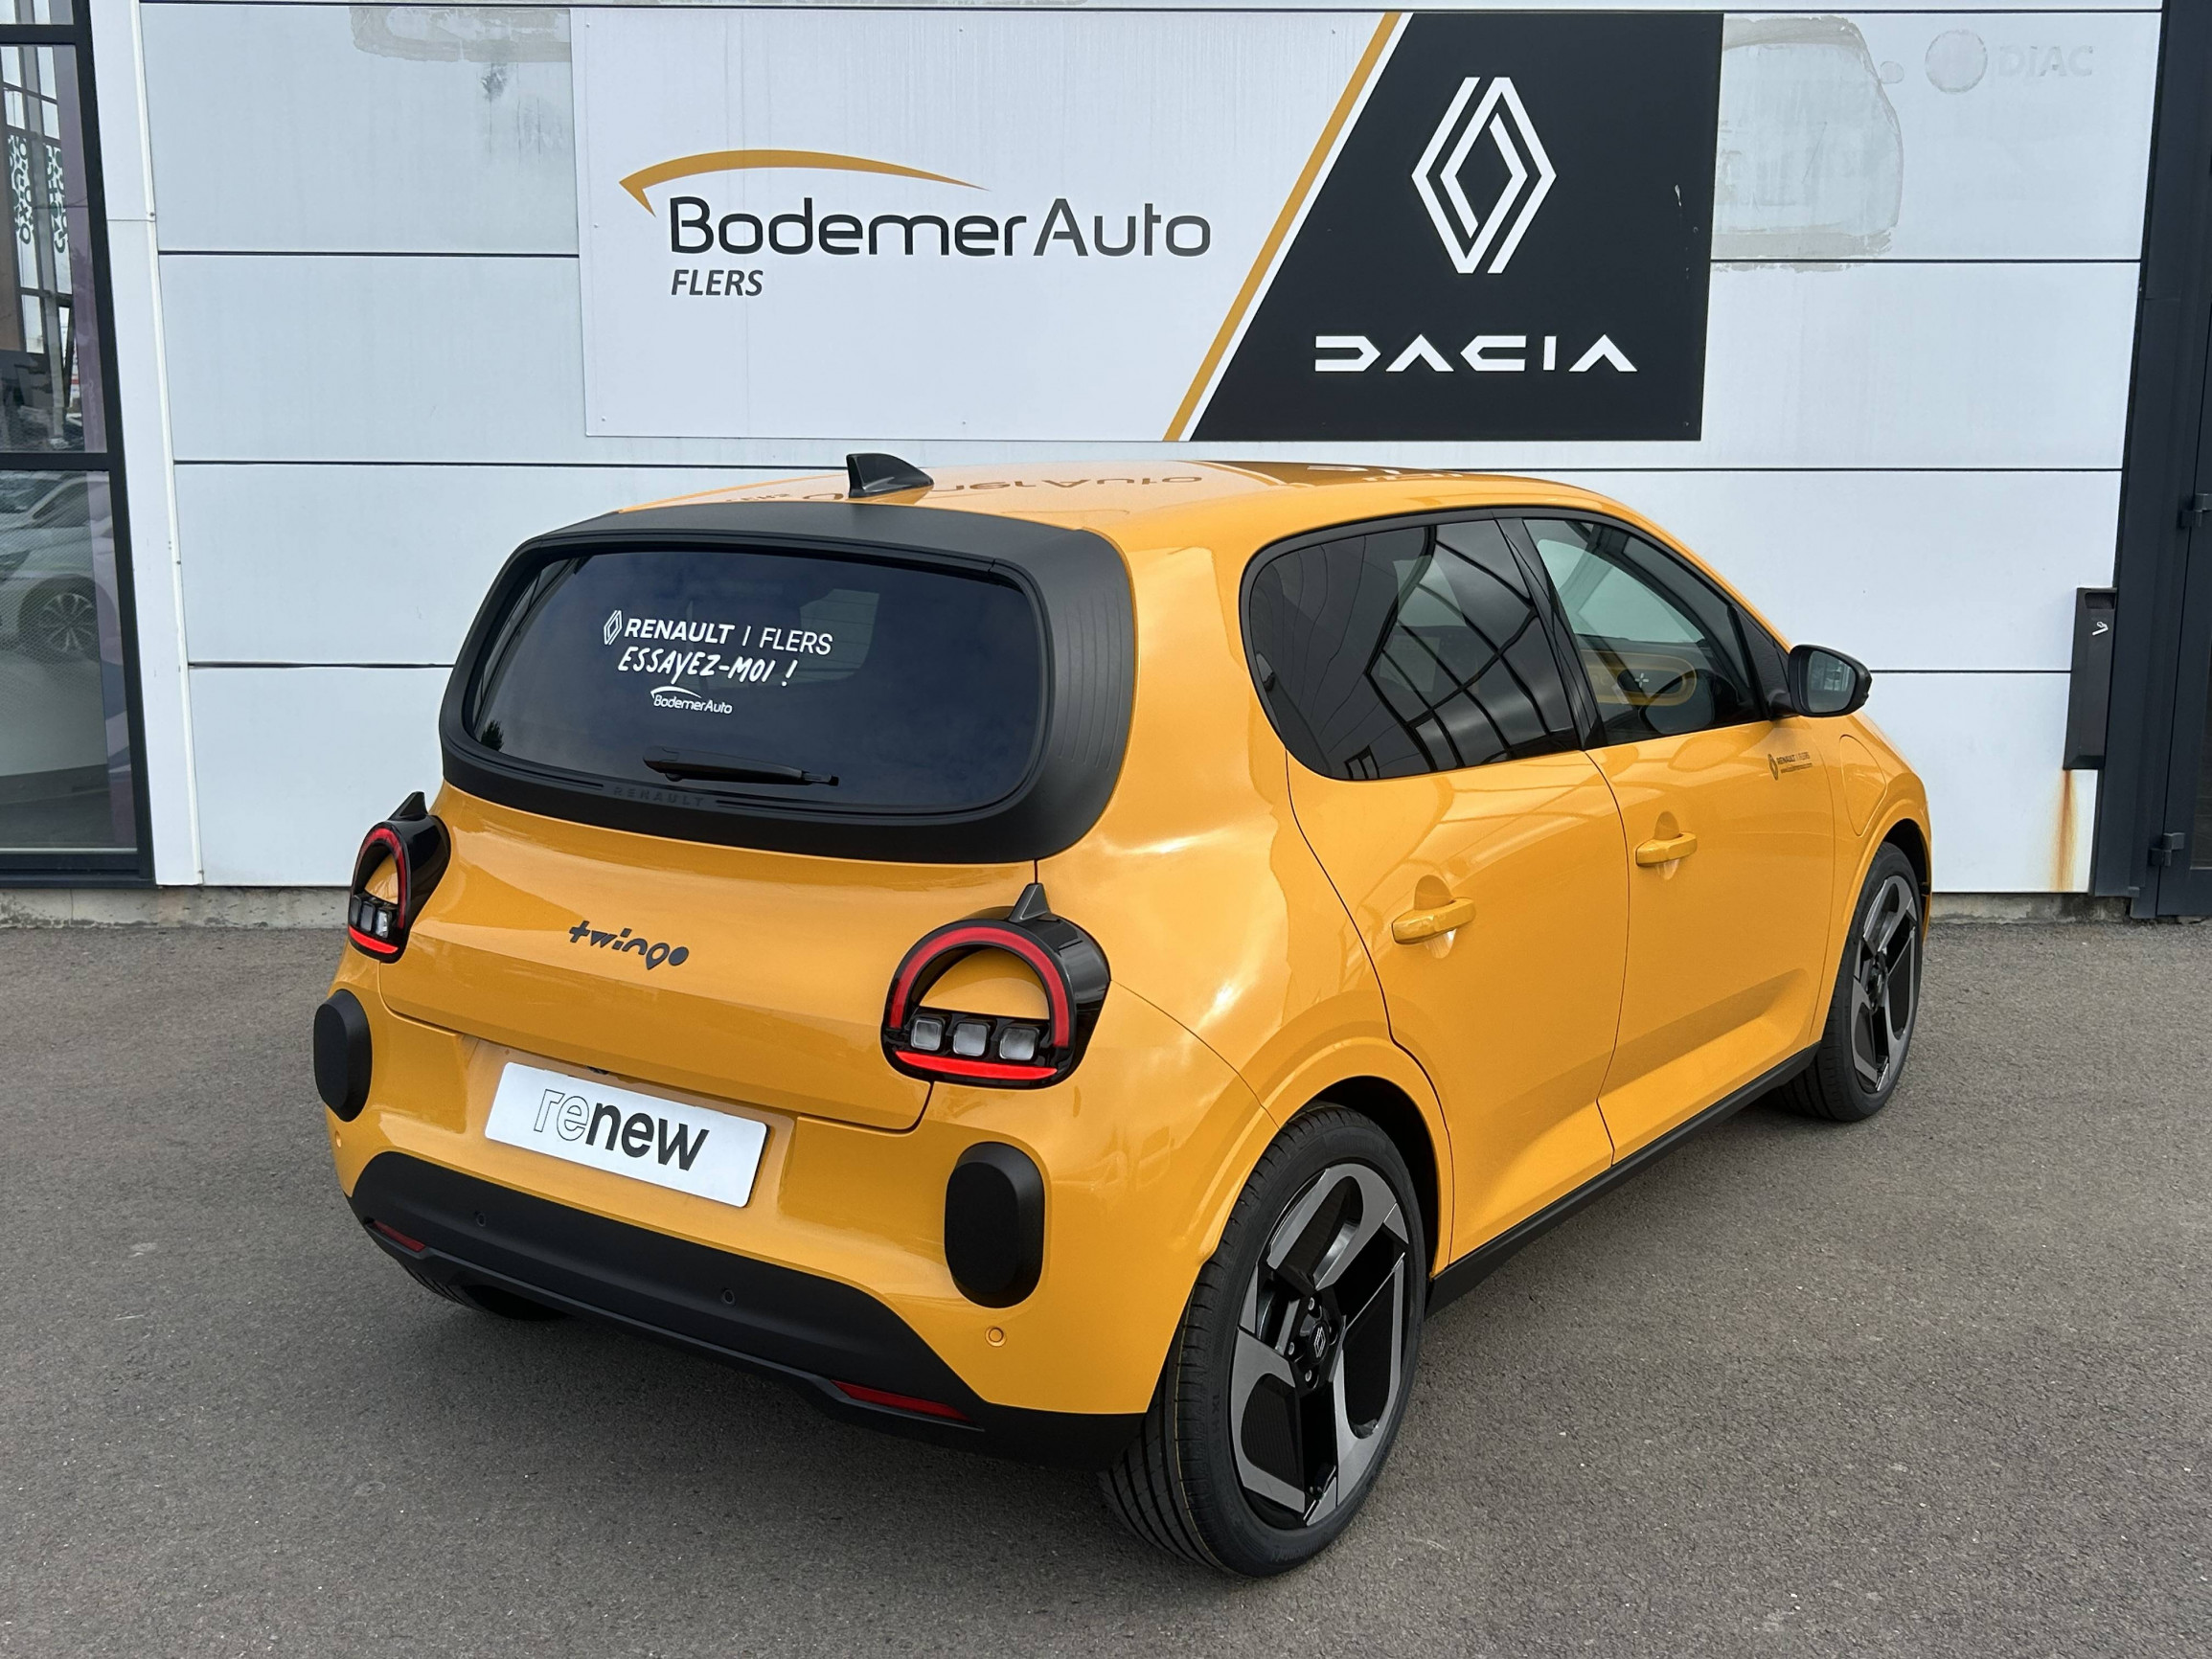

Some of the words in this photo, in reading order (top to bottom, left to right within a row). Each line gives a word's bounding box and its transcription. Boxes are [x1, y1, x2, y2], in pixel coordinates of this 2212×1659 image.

[671, 269, 764, 295] FLERS
[1314, 333, 1638, 372] DACIA
[625, 618, 735, 645] RENAULT
[760, 627, 833, 655] FLERS
[618, 647, 776, 685] ESSAYEZ-MOI
[653, 694, 733, 714] BodemerAuto
[613, 786, 704, 807] RENAULT
[568, 920, 690, 970] twingo
[534, 1088, 710, 1171] renew
